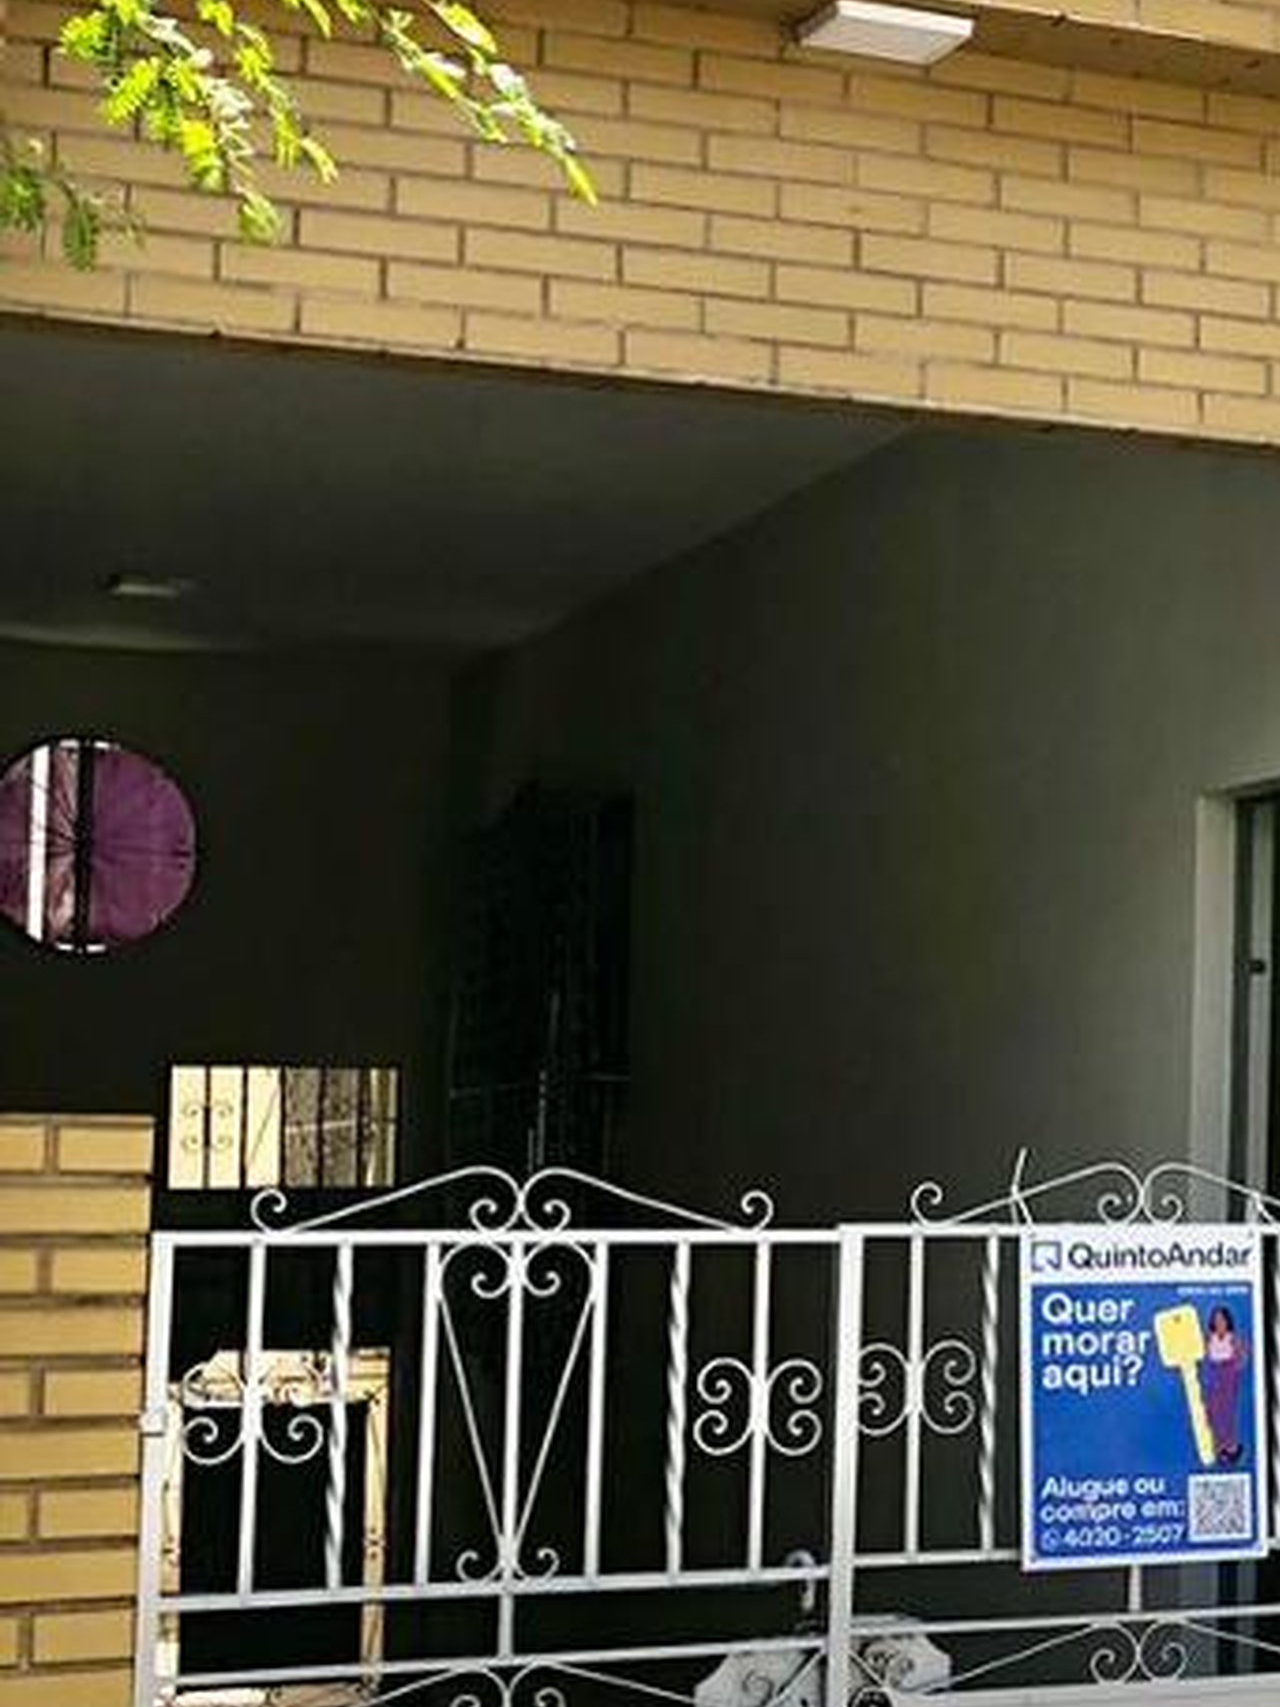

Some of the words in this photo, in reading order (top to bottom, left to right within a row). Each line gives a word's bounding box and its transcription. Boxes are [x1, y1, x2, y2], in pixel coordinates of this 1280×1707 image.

[1067, 1242, 1252, 1270] QuintoAndar
[1041, 1292, 1135, 1325] Quer
[1041, 1327, 1151, 1356] morar
[1041, 1356, 1144, 1395] aqui?
[1040, 1476, 1129, 1501] Alugue
[1134, 1476, 1166, 1495] ou
[1040, 1499, 1138, 1523] compre
[1141, 1498, 1186, 1519] em:
